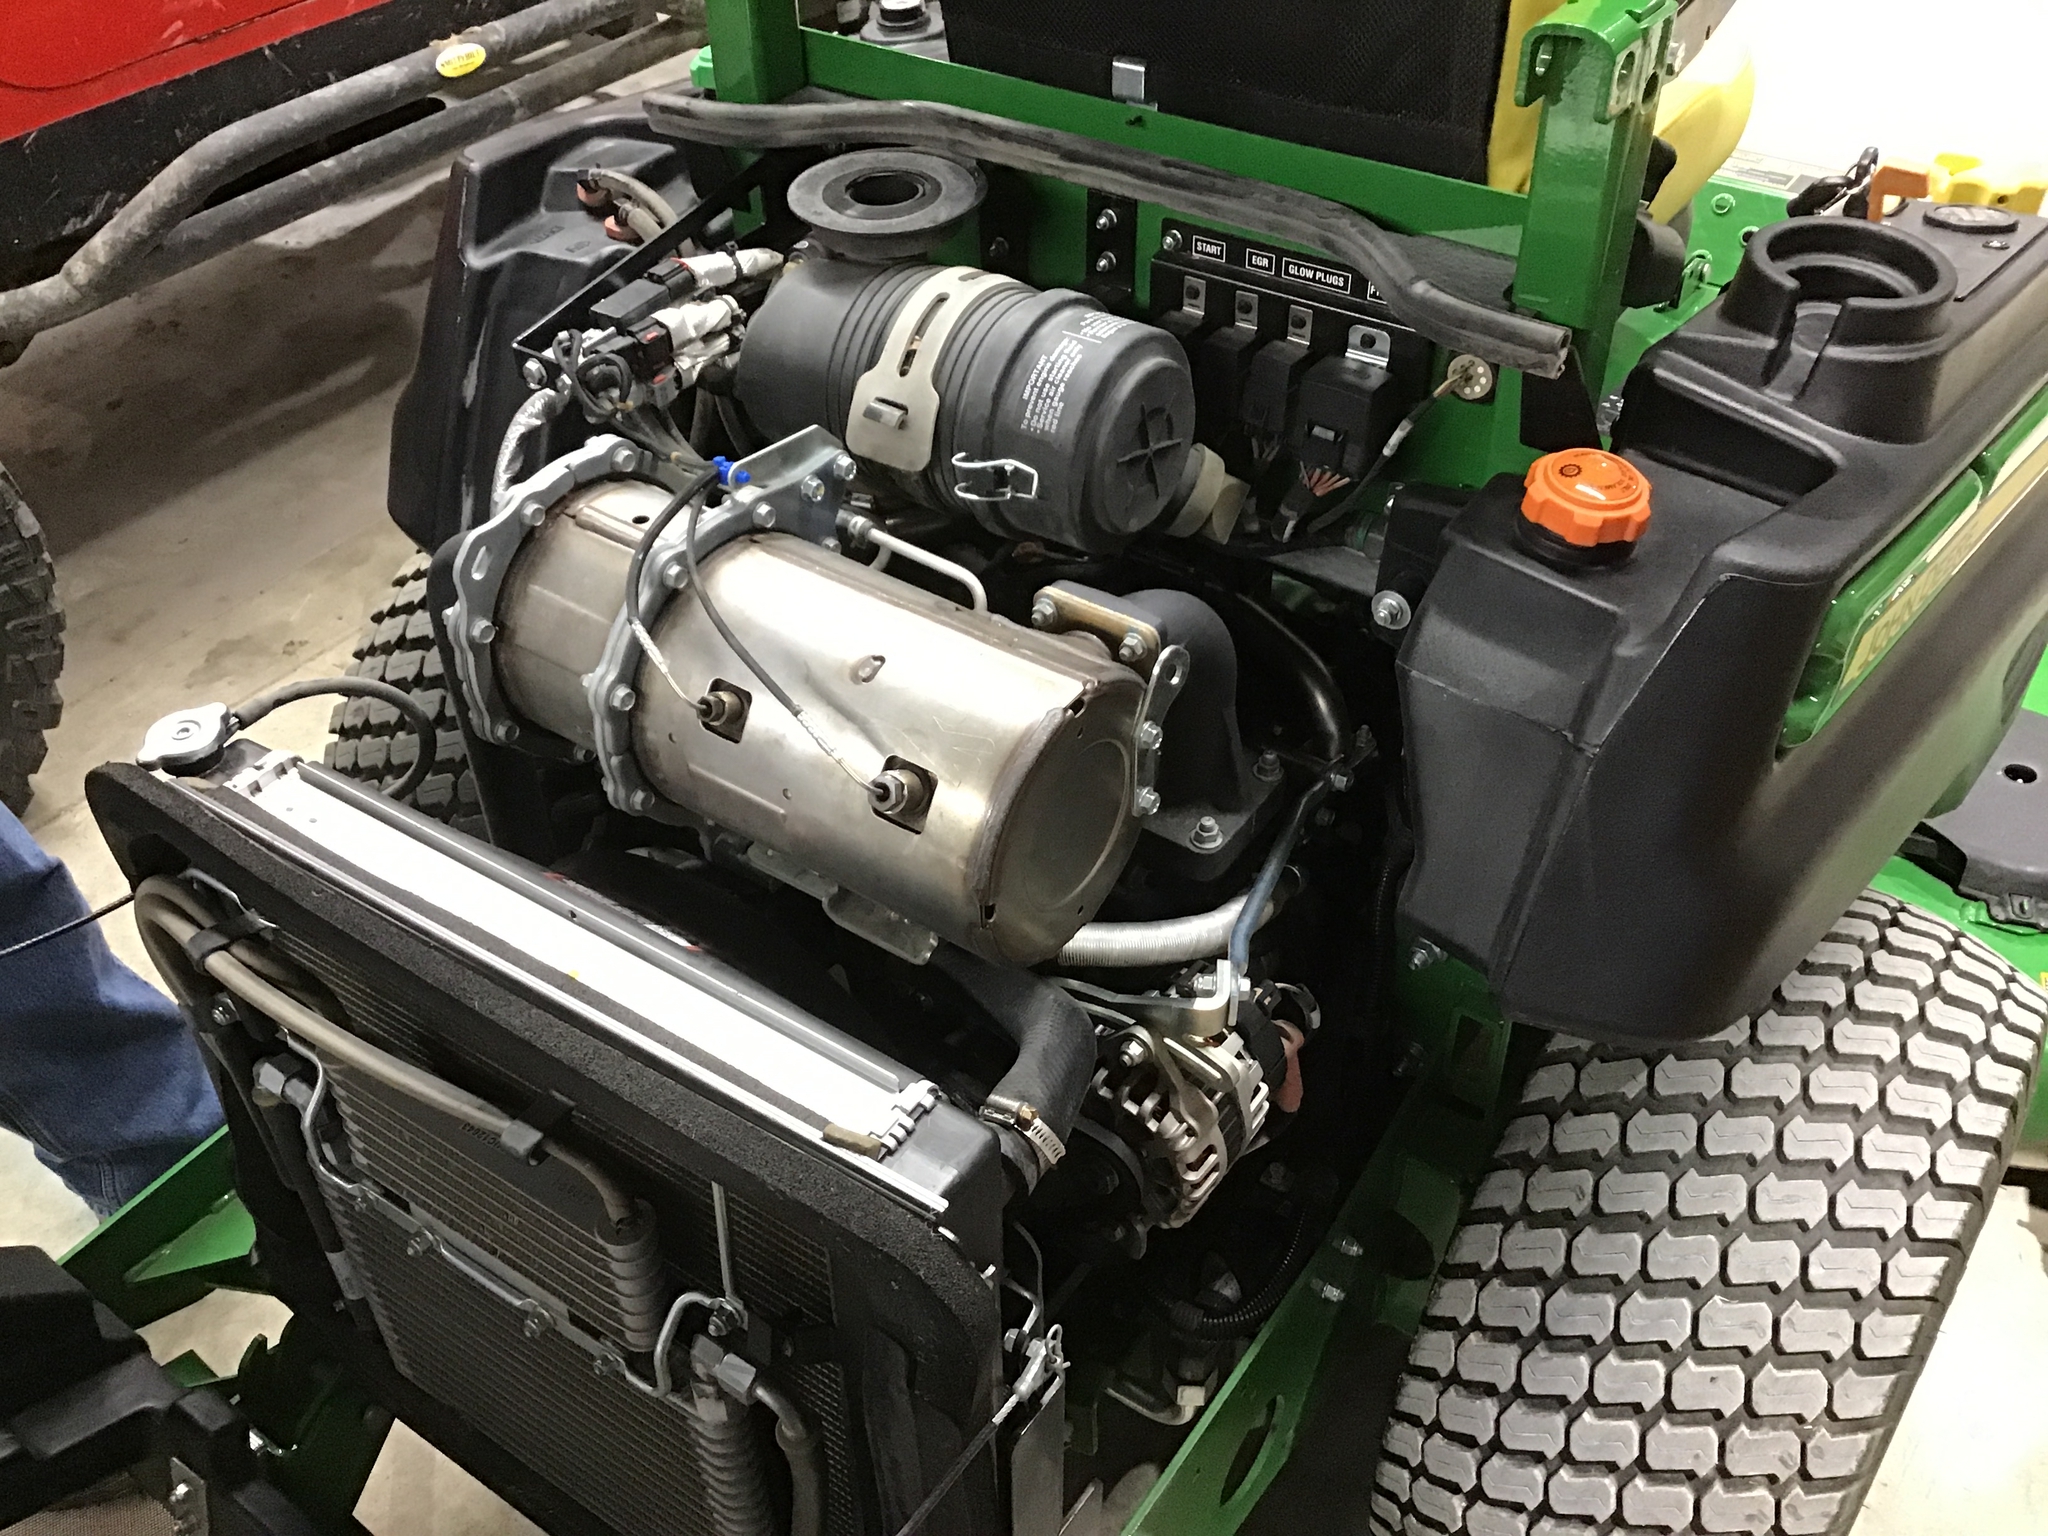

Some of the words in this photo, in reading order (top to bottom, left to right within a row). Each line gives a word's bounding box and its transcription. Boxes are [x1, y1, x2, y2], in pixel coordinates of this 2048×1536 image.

[1196, 241, 1222, 256] START
[1251, 254, 1269, 268] EGR
[1288, 264, 1315, 280] GLOW
[1315, 271, 1344, 287] PLUGS
[1022, 354, 1047, 400] IMPORTANT
[1035, 399, 1044, 413] not
[1041, 382, 1051, 398] use
[1048, 354, 1068, 381] starting
[1036, 398, 1051, 429] Service
[1054, 357, 1071, 384] cleaner
[1044, 408, 1055, 431] when
[1051, 382, 1066, 407] gauge
[1063, 354, 1082, 381] reaches
[1020, 418, 1029, 429] To
[1025, 387, 1040, 418] prevent
[1036, 362, 1052, 387] engine
[1054, 401, 1065, 417] line
[1050, 418, 1059, 433] red
